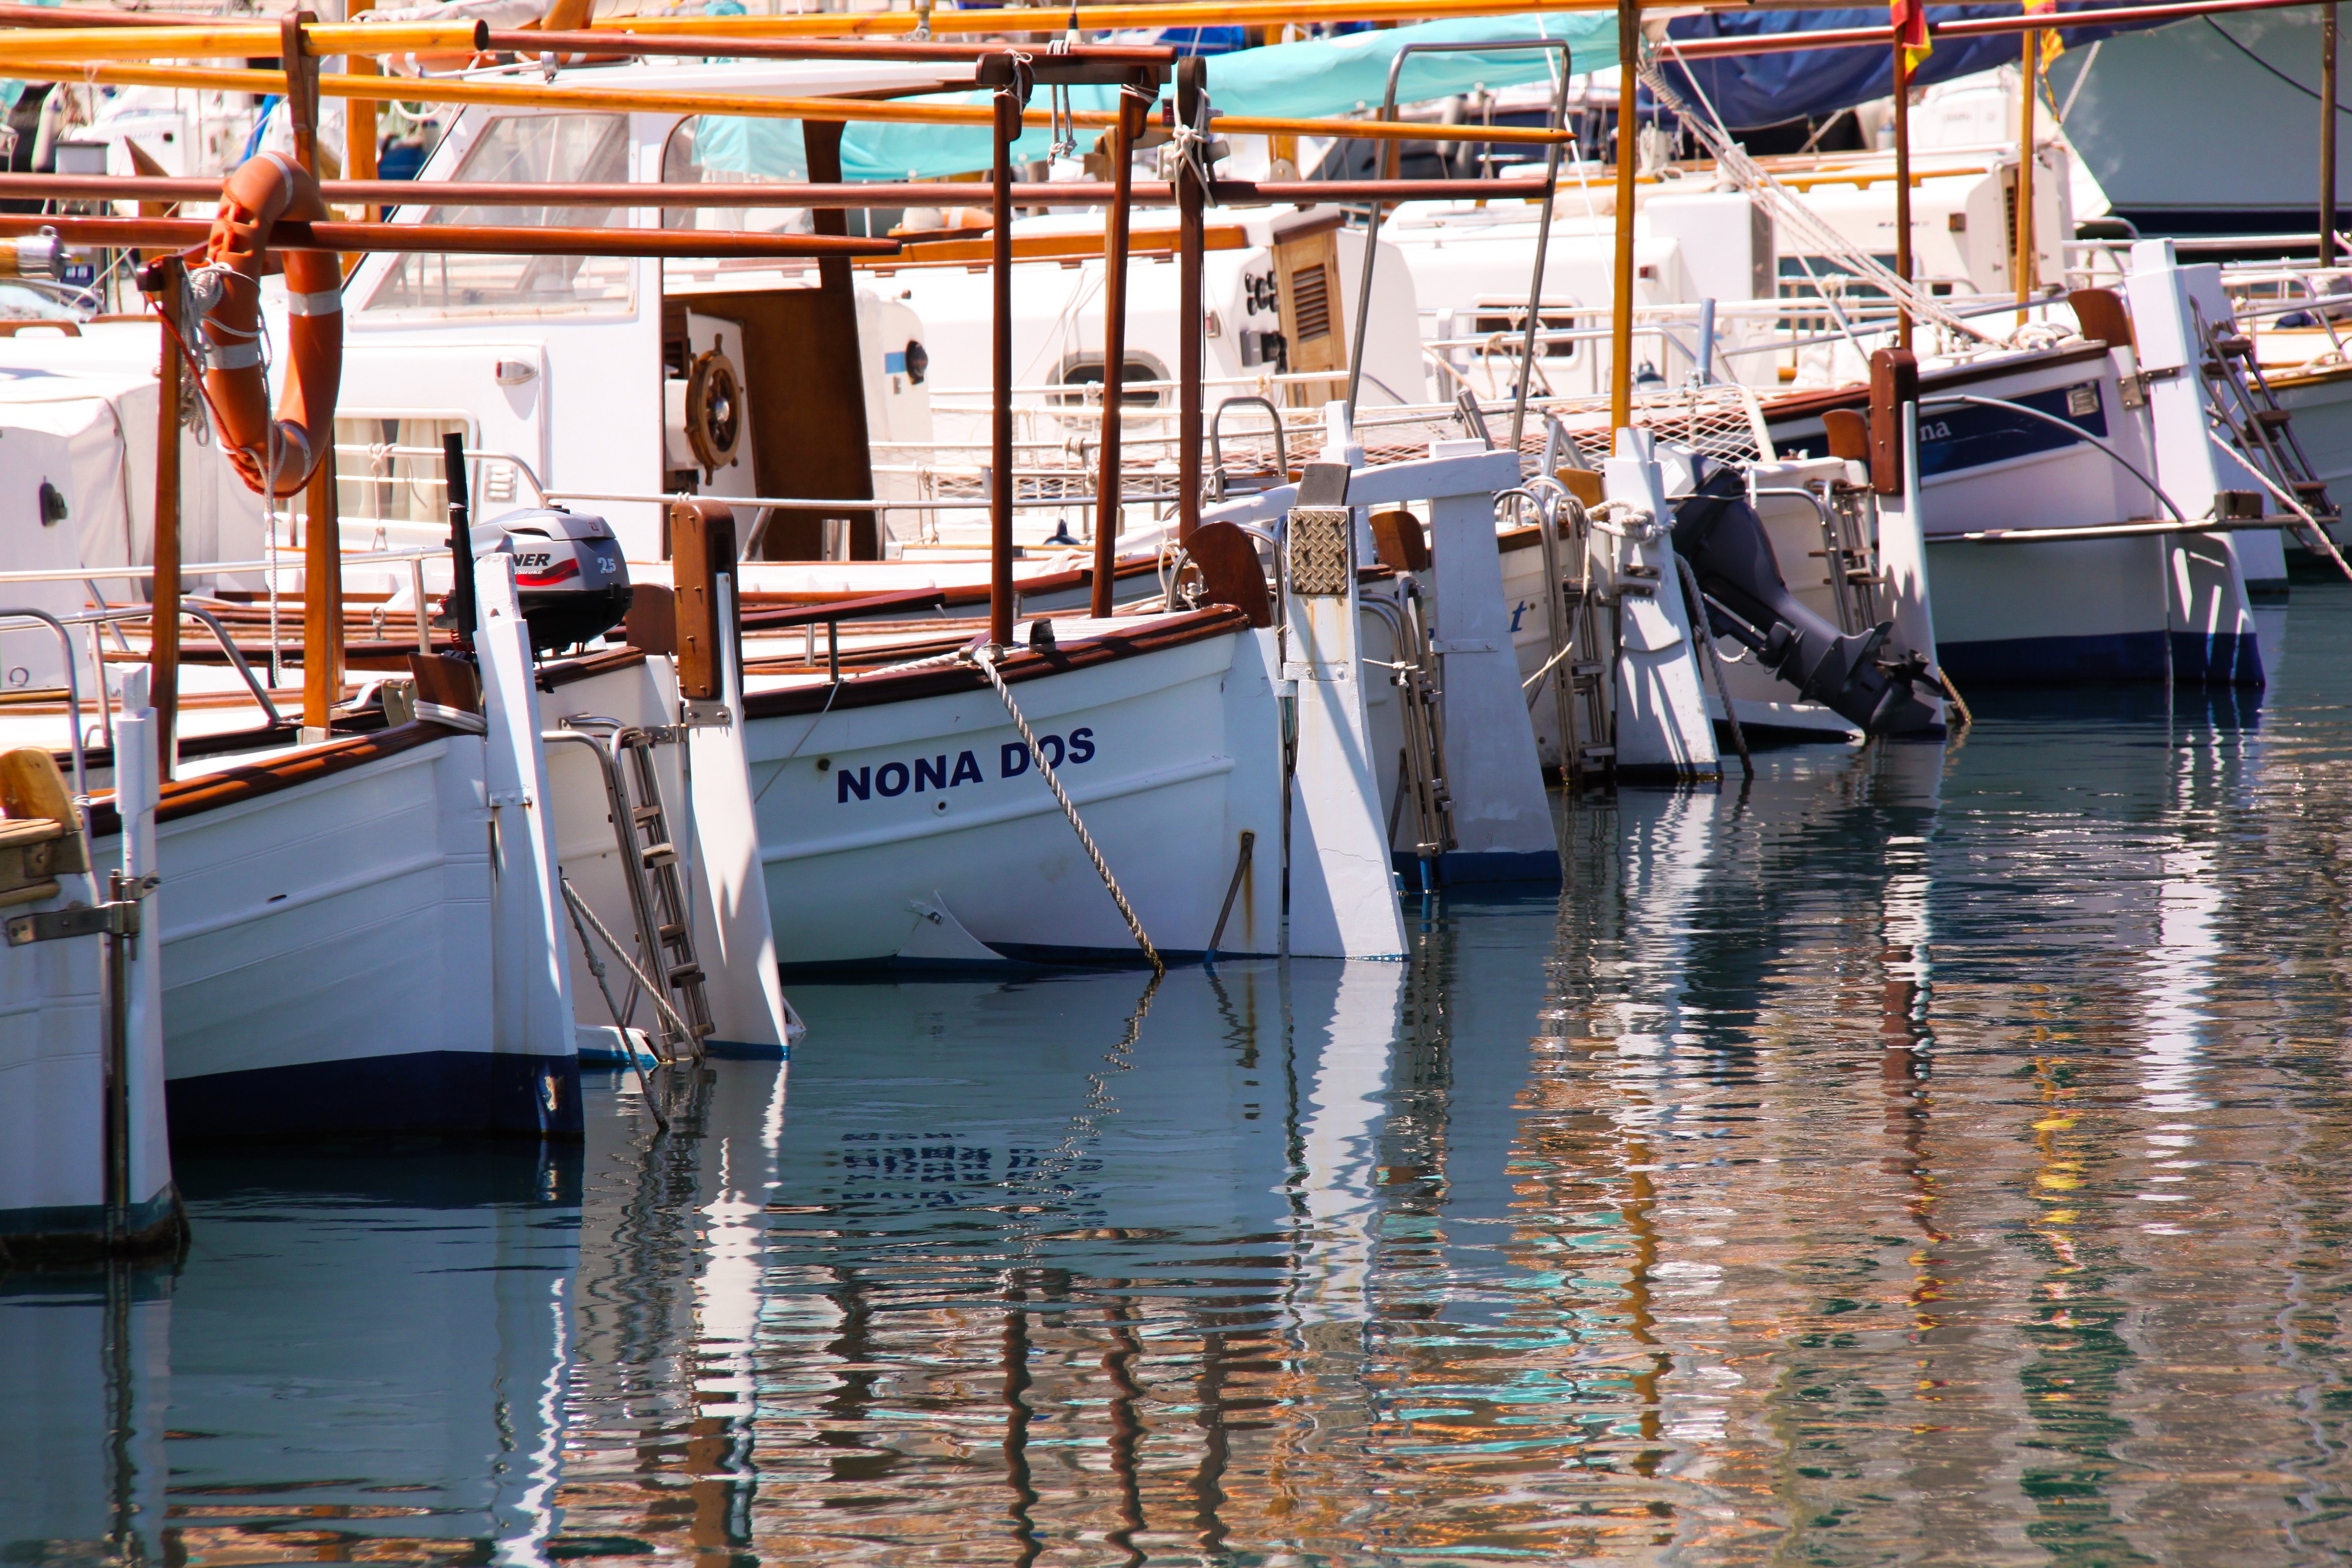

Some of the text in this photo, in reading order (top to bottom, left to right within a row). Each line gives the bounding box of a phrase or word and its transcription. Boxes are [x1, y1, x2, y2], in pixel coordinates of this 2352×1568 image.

[597, 557, 617, 574] 25
[838, 728, 1095, 803] NONA DOS
